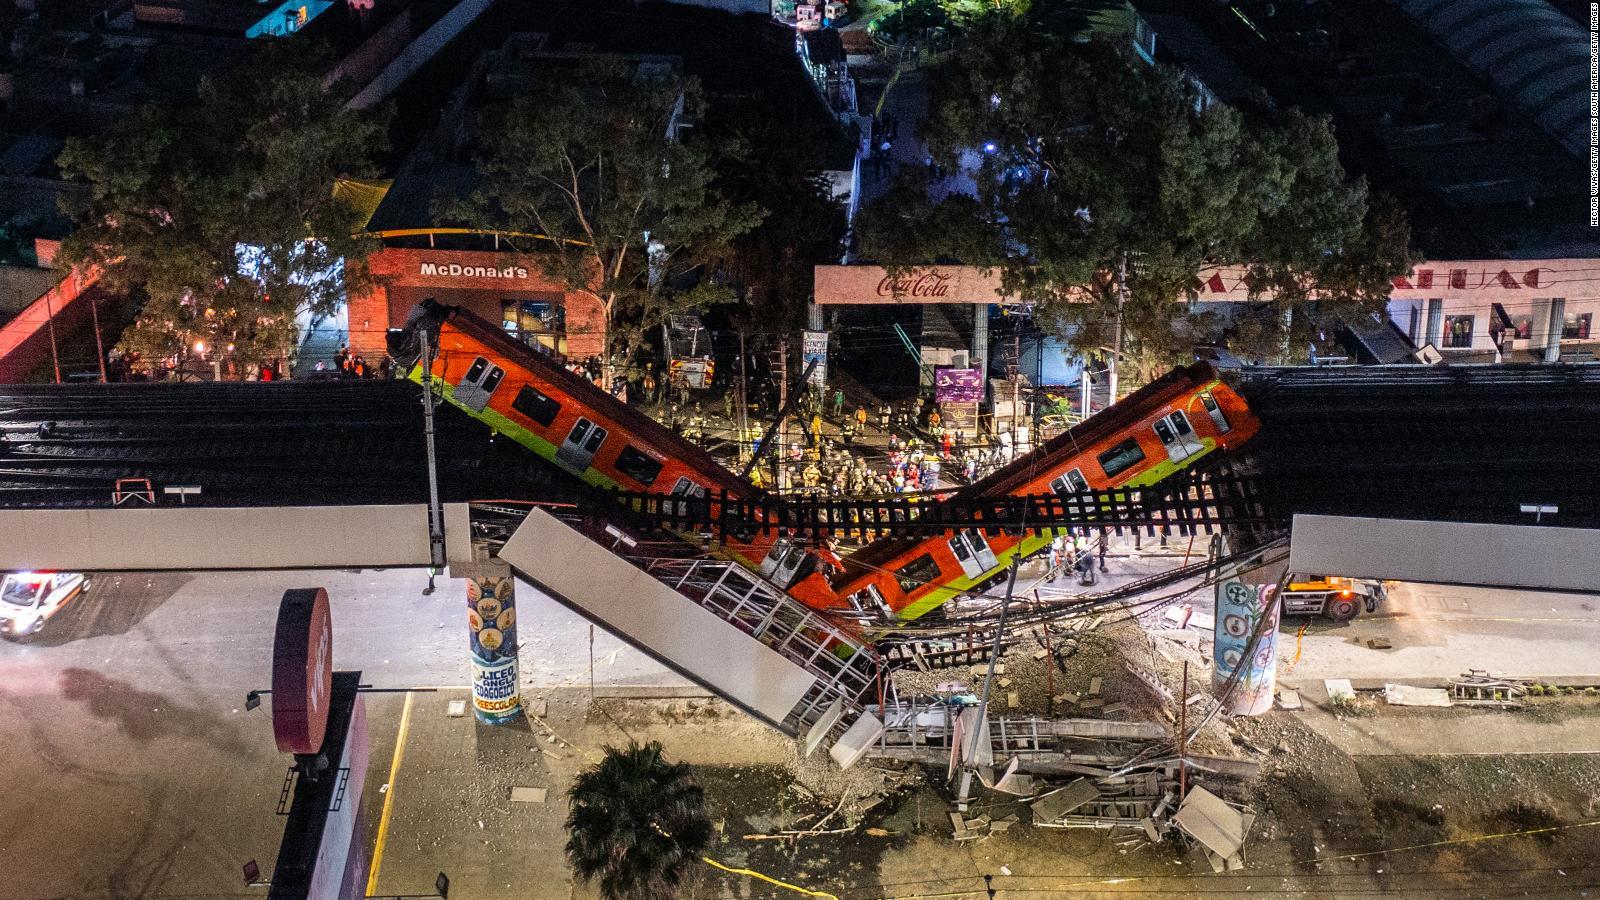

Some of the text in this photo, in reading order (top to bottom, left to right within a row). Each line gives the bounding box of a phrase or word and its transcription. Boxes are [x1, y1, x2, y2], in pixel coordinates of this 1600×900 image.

[420, 263, 528, 279] McDonald's
[481, 665, 514, 680] LICEO
[483, 673, 516, 687] ANGLO
